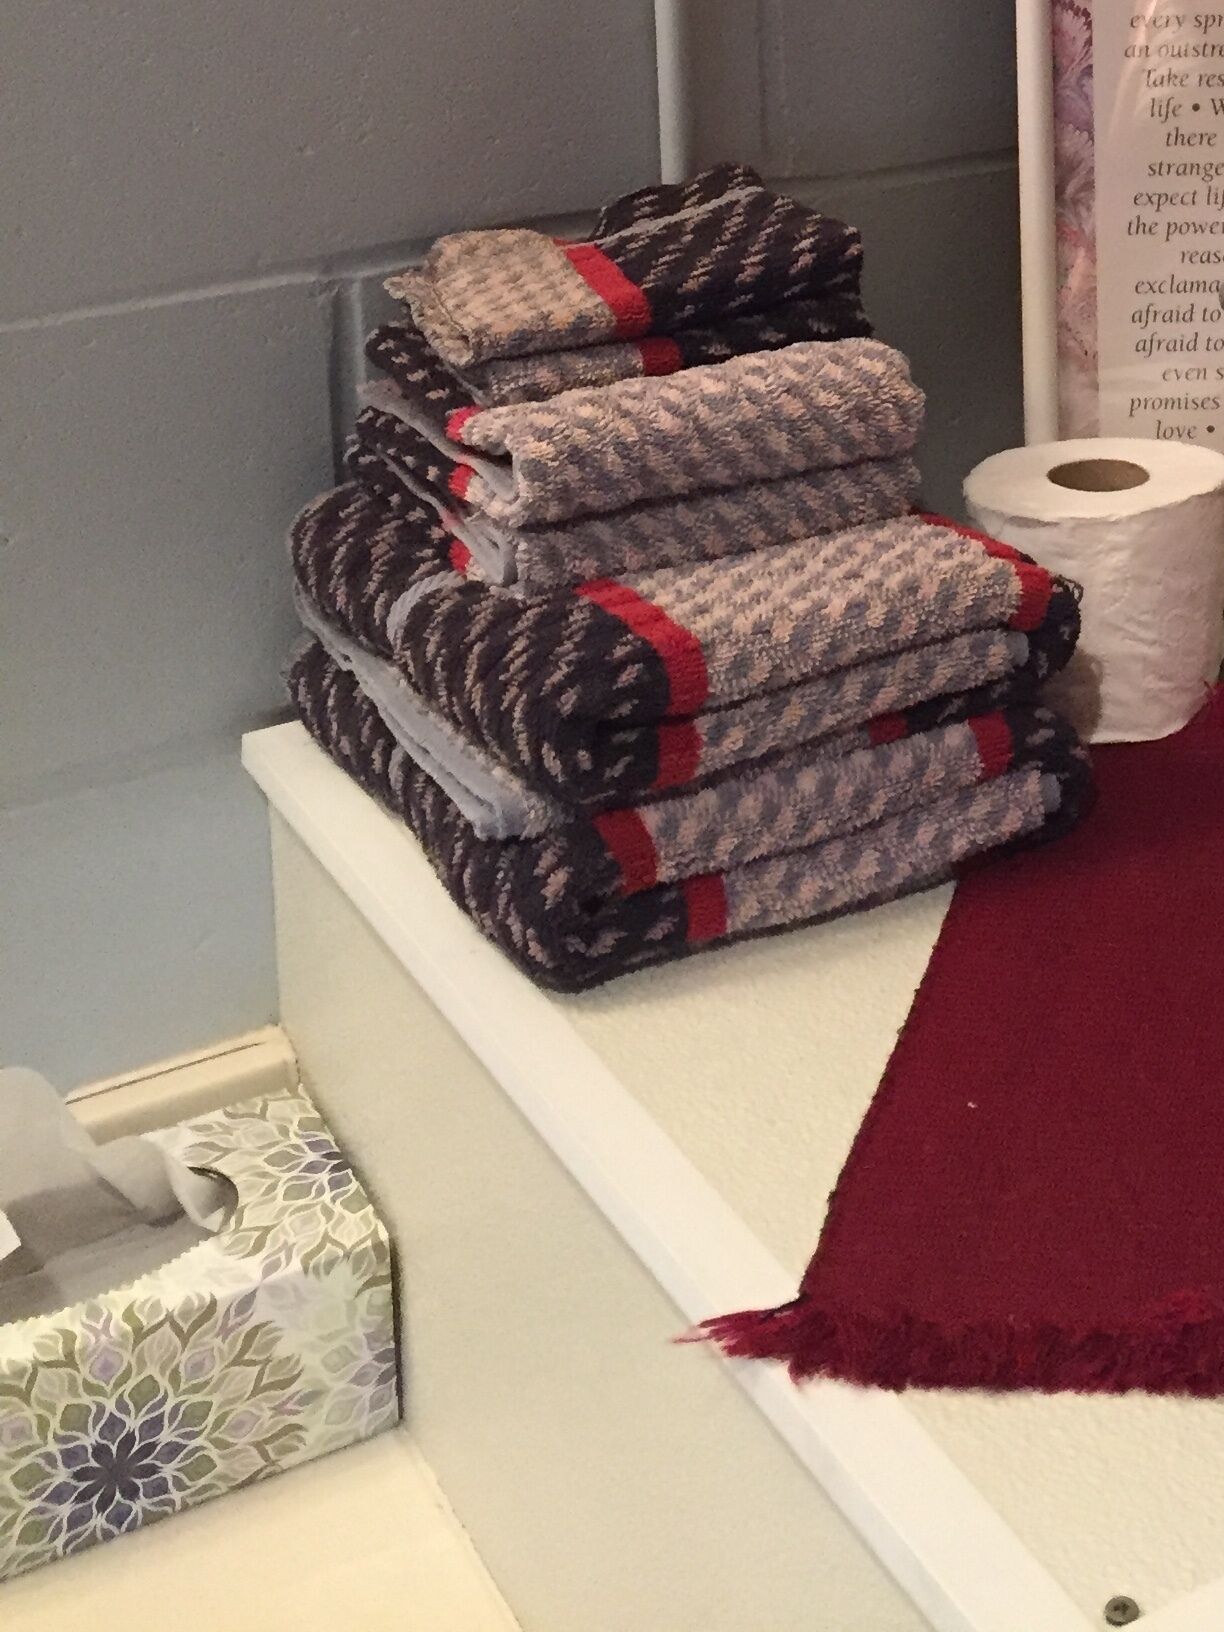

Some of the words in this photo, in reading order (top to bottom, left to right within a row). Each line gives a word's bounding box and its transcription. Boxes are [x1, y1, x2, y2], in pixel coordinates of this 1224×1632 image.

[1150, 96, 1183, 124] life
[1165, 126, 1218, 148] there
[1132, 189, 1198, 213] expect
[1126, 214, 1159, 237] the
[1130, 302, 1195, 331] afraid
[1134, 331, 1199, 360] afraid
[1128, 396, 1221, 418] promises
[1155, 419, 1197, 440] love
